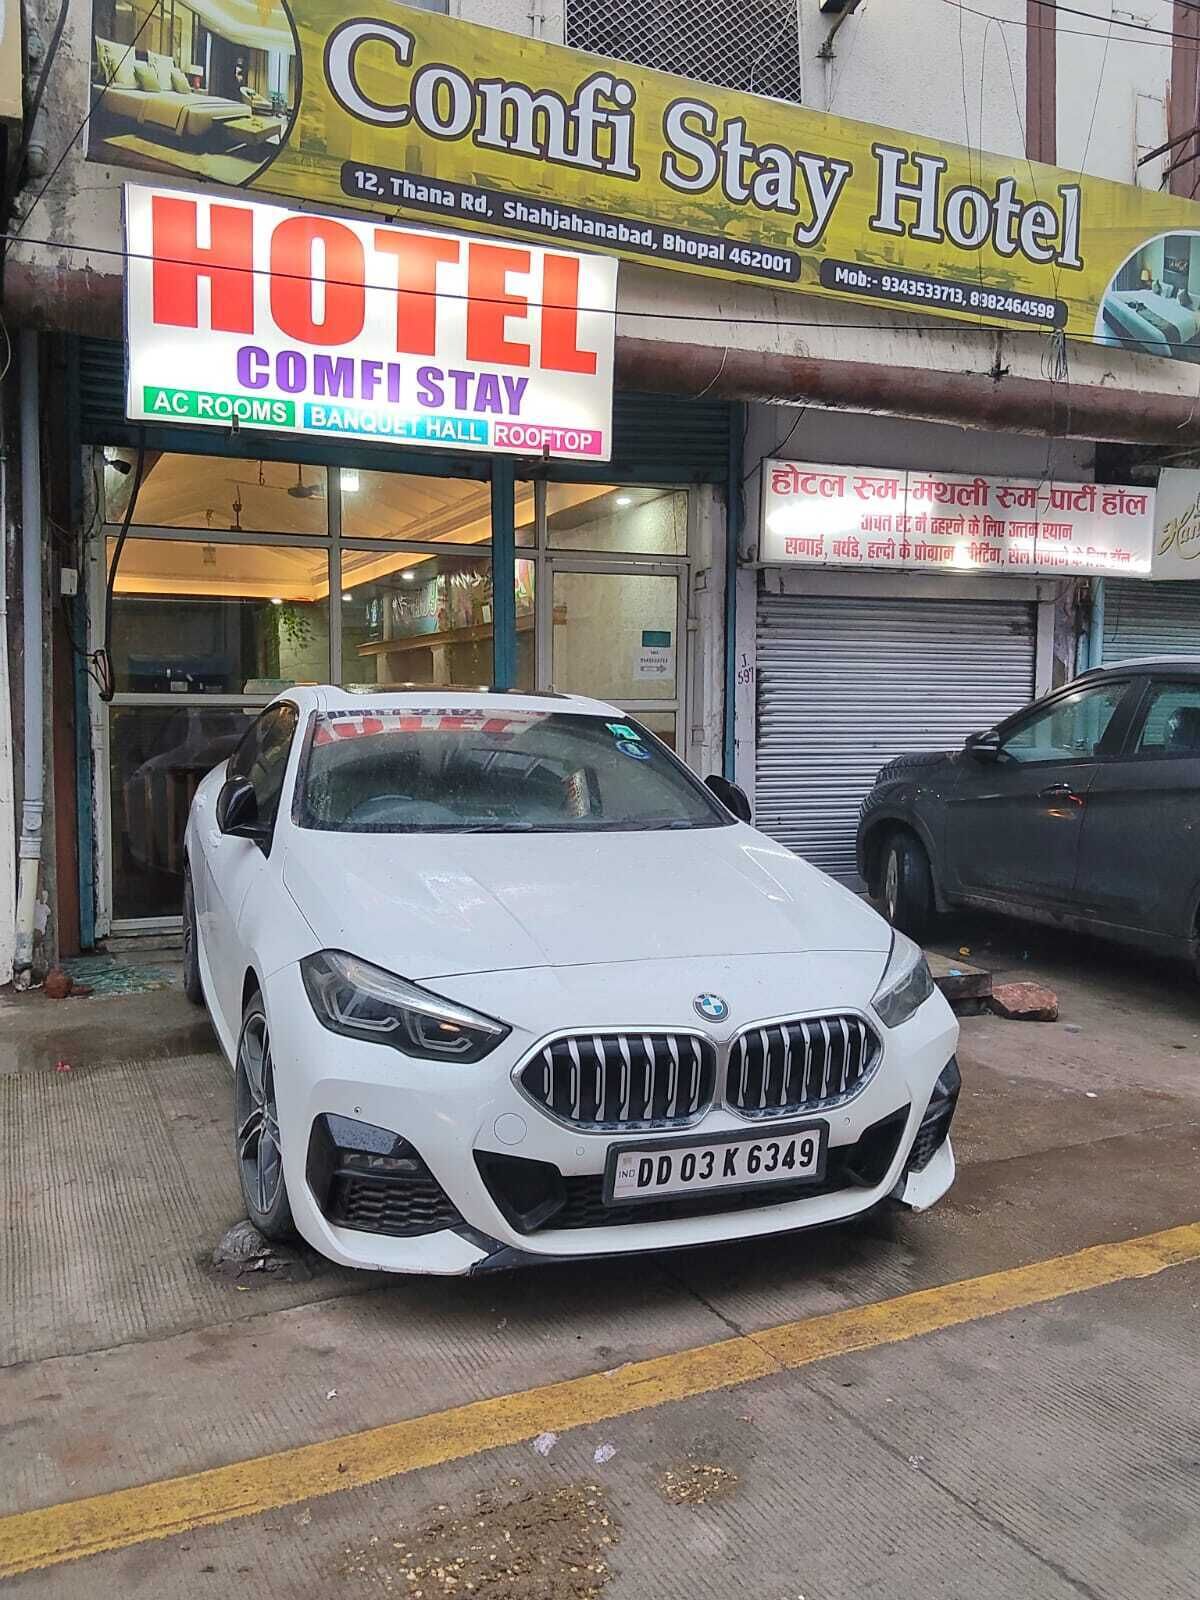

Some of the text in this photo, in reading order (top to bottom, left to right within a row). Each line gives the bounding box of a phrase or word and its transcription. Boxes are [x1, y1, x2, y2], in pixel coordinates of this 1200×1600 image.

[324, 17, 1084, 270] Comfi Stay Hotel
[354, 171, 792, 274] 12, Thana Rd, Shahjahanabad, Bhopal 462001
[152, 195, 597, 376] HOTEL
[834, 267, 1055, 320] Mob:- 9343533713, 8982464598
[236, 345, 529, 416] COMFI STAY
[153, 390, 288, 423] AC ROOMS
[311, 406, 482, 442] BANQUET HALL
[495, 425, 593, 450] ROOFTOP
[771, 464, 847, 498] होटल
[1102, 489, 1148, 516] हॉल
[899, 538, 912, 560] के
[968, 515, 981, 537] के
[983, 515, 1006, 538] लिए
[618, 1169, 636, 1179] IND
[637, 1138, 815, 1188] DD 03 K 6349
